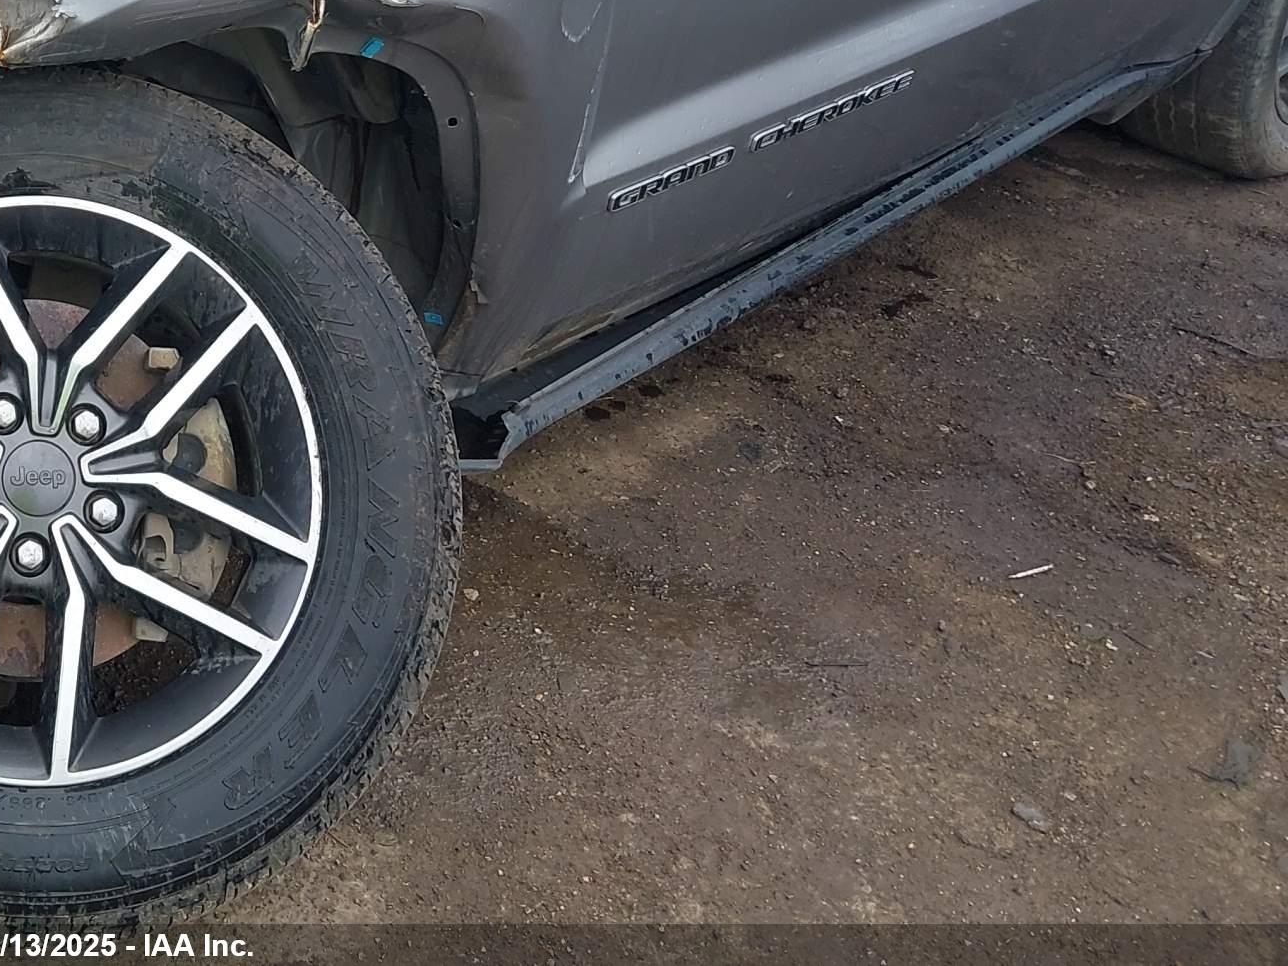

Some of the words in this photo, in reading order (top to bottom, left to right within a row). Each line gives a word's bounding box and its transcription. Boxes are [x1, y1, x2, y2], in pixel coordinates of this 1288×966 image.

[607, 145, 736, 212] GRAND
[749, 68, 915, 153] CHEROKEE
[10, 465, 66, 489] Jeep
